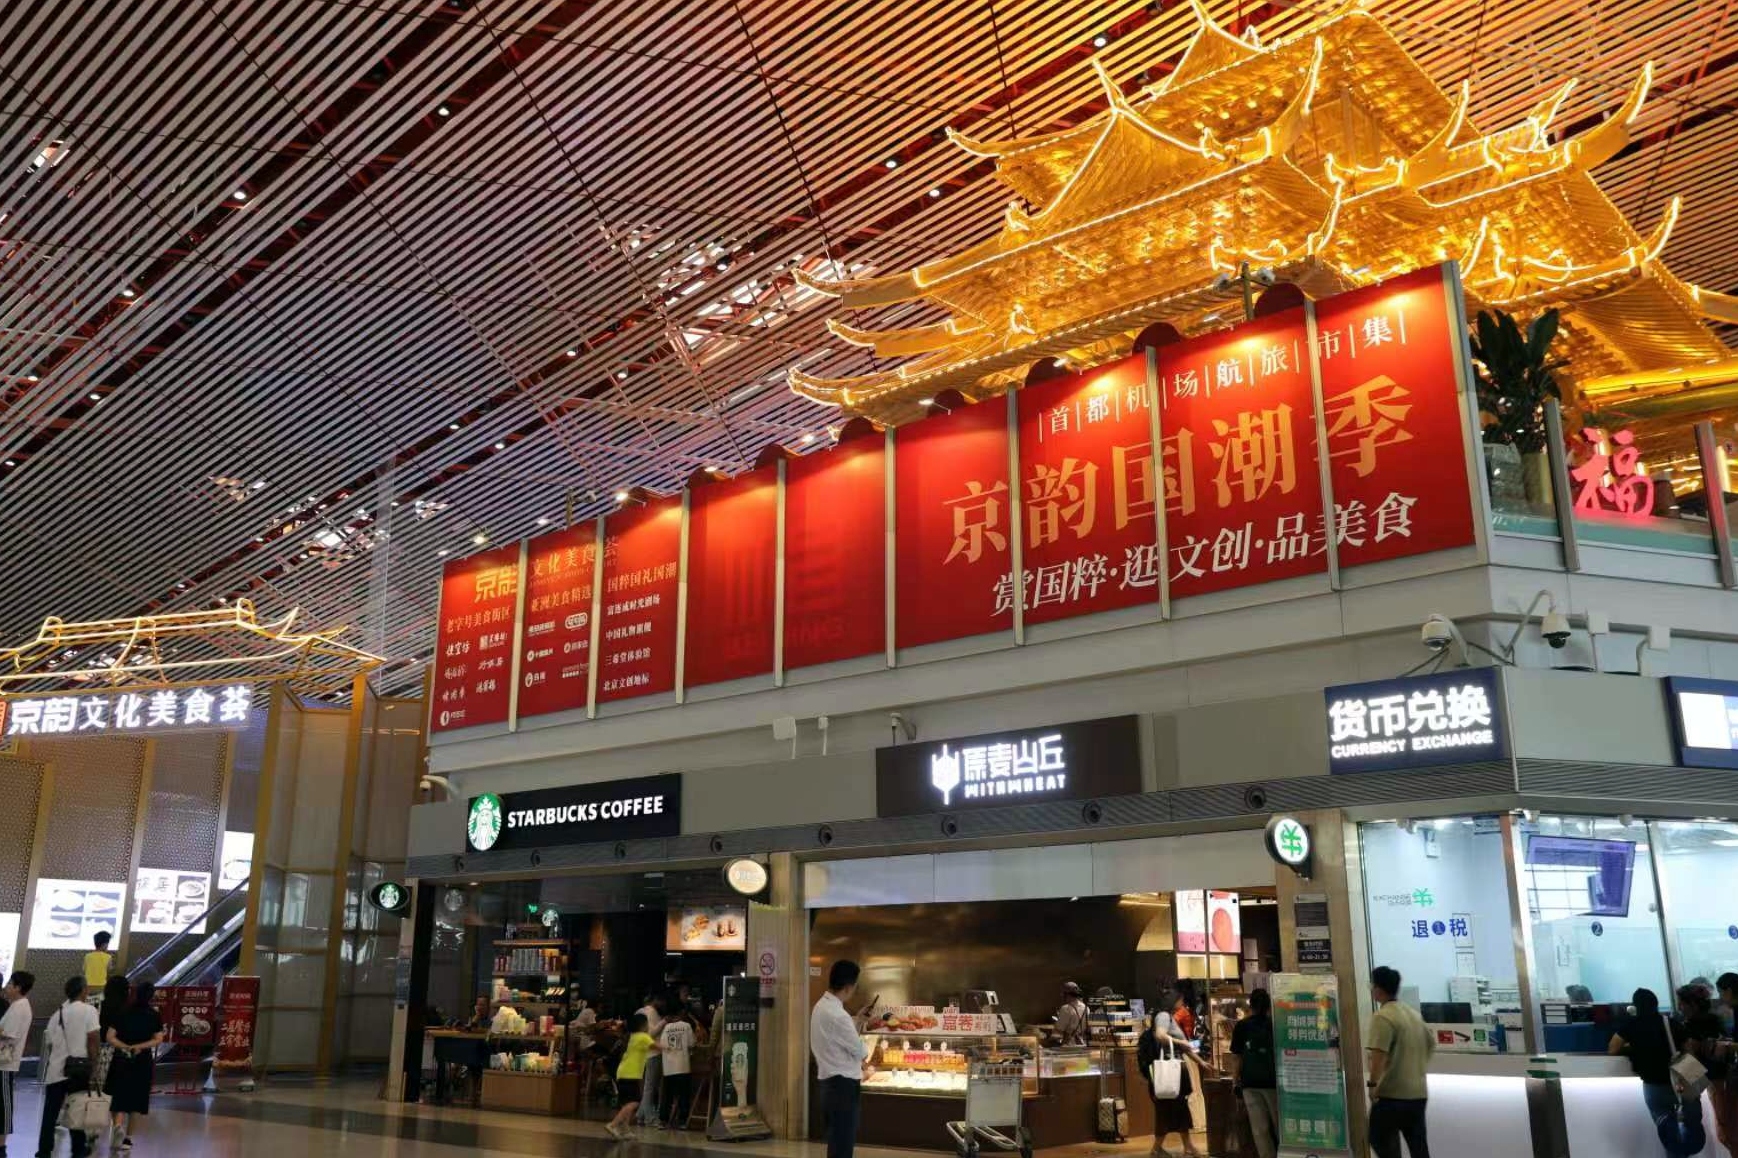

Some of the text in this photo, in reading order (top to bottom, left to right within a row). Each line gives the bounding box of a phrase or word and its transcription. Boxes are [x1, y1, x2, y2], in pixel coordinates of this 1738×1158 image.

[943, 374, 1414, 566] 京韵国潮季
[8, 684, 253, 736] 京韵文化美食荟
[1328, 684, 1492, 743] 货币兑换
[962, 733, 1066, 782] 原麦山丘
[1330, 728, 1494, 760] CURRENCY EXCHANGE
[507, 795, 664, 829] STARBUCKS COFFEE
